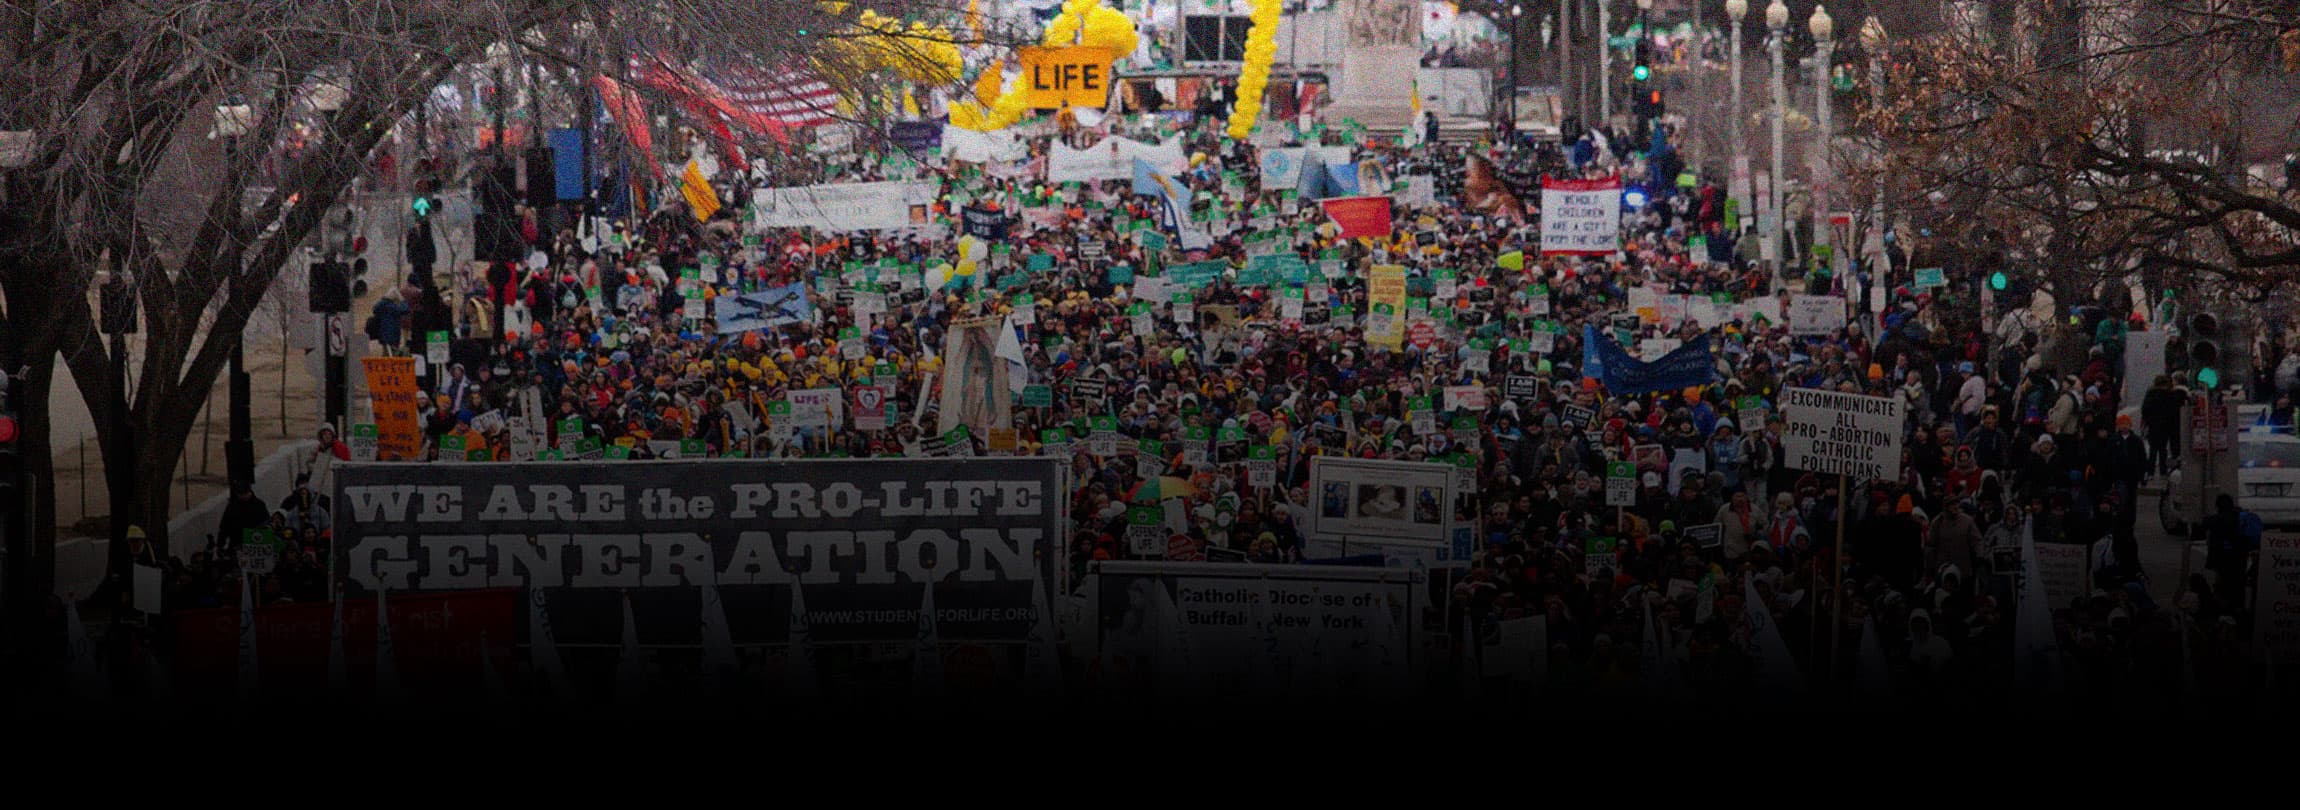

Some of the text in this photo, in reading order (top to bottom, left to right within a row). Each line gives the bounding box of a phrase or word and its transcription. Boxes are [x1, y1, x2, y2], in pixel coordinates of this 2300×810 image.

[1034, 63, 1099, 90] LIFE
[1557, 207, 1604, 218] CHILDREN
[794, 395, 819, 404] LIFE
[1791, 390, 1896, 416] EXCOMMUNICATE
[1836, 412, 1857, 429] ALL
[1812, 440, 1873, 461] CATHOLIC
[1801, 455, 1882, 479] POLITICIANS
[1607, 478, 1634, 490] DEFEND
[345, 481, 1041, 522] WE ARE the PRO-LIFE
[350, 527, 1044, 591] GENERATION
[1352, 592, 1372, 607] of
[1321, 613, 1364, 629] York
